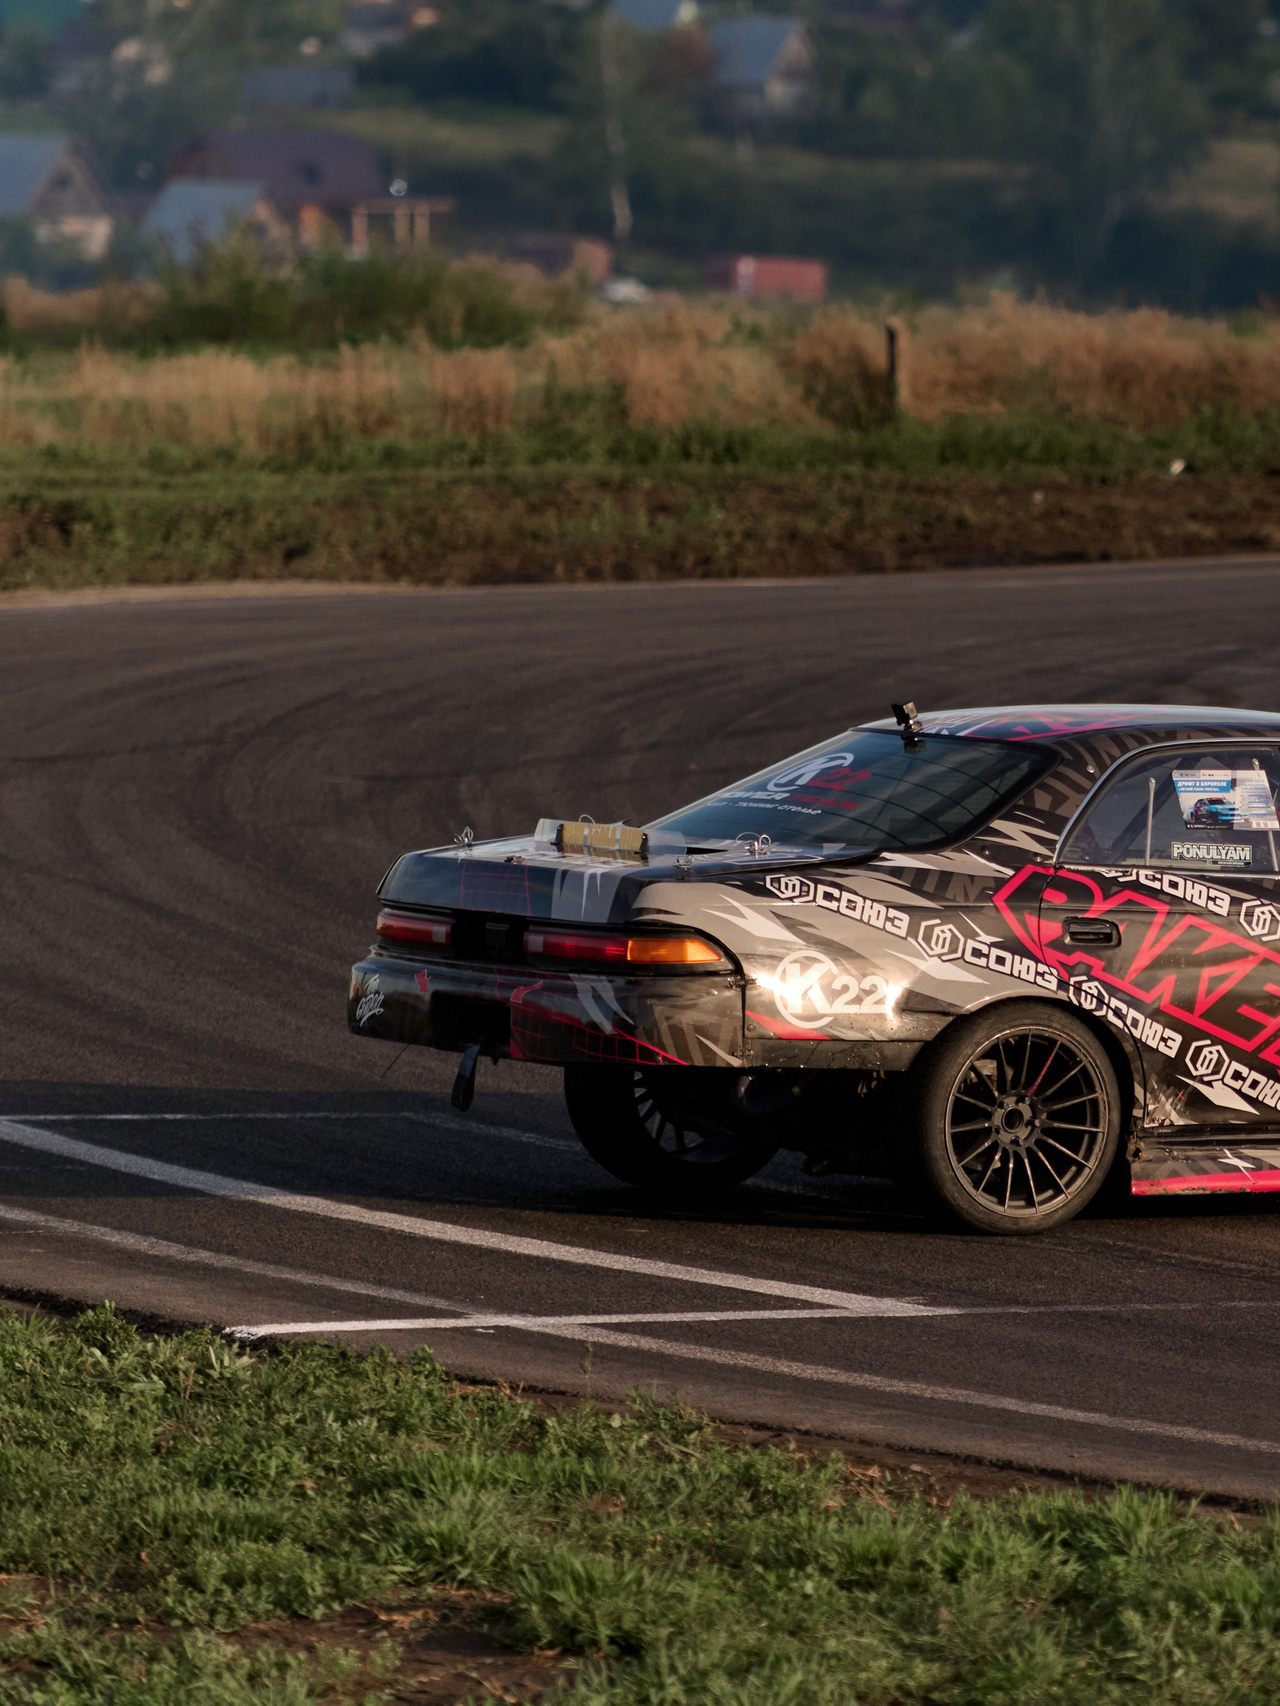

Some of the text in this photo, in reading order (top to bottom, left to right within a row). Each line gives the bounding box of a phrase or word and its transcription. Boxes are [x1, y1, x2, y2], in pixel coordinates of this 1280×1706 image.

[1173, 843, 1251, 861] PONULYAM
[816, 883, 910, 938] СОЮЗ
[1139, 870, 1232, 917] СОЮЗ
[775, 952, 889, 1024] K22
[963, 938, 1058, 994] СОЮЗ
[1106, 999, 1183, 1059] СОЮЗ
